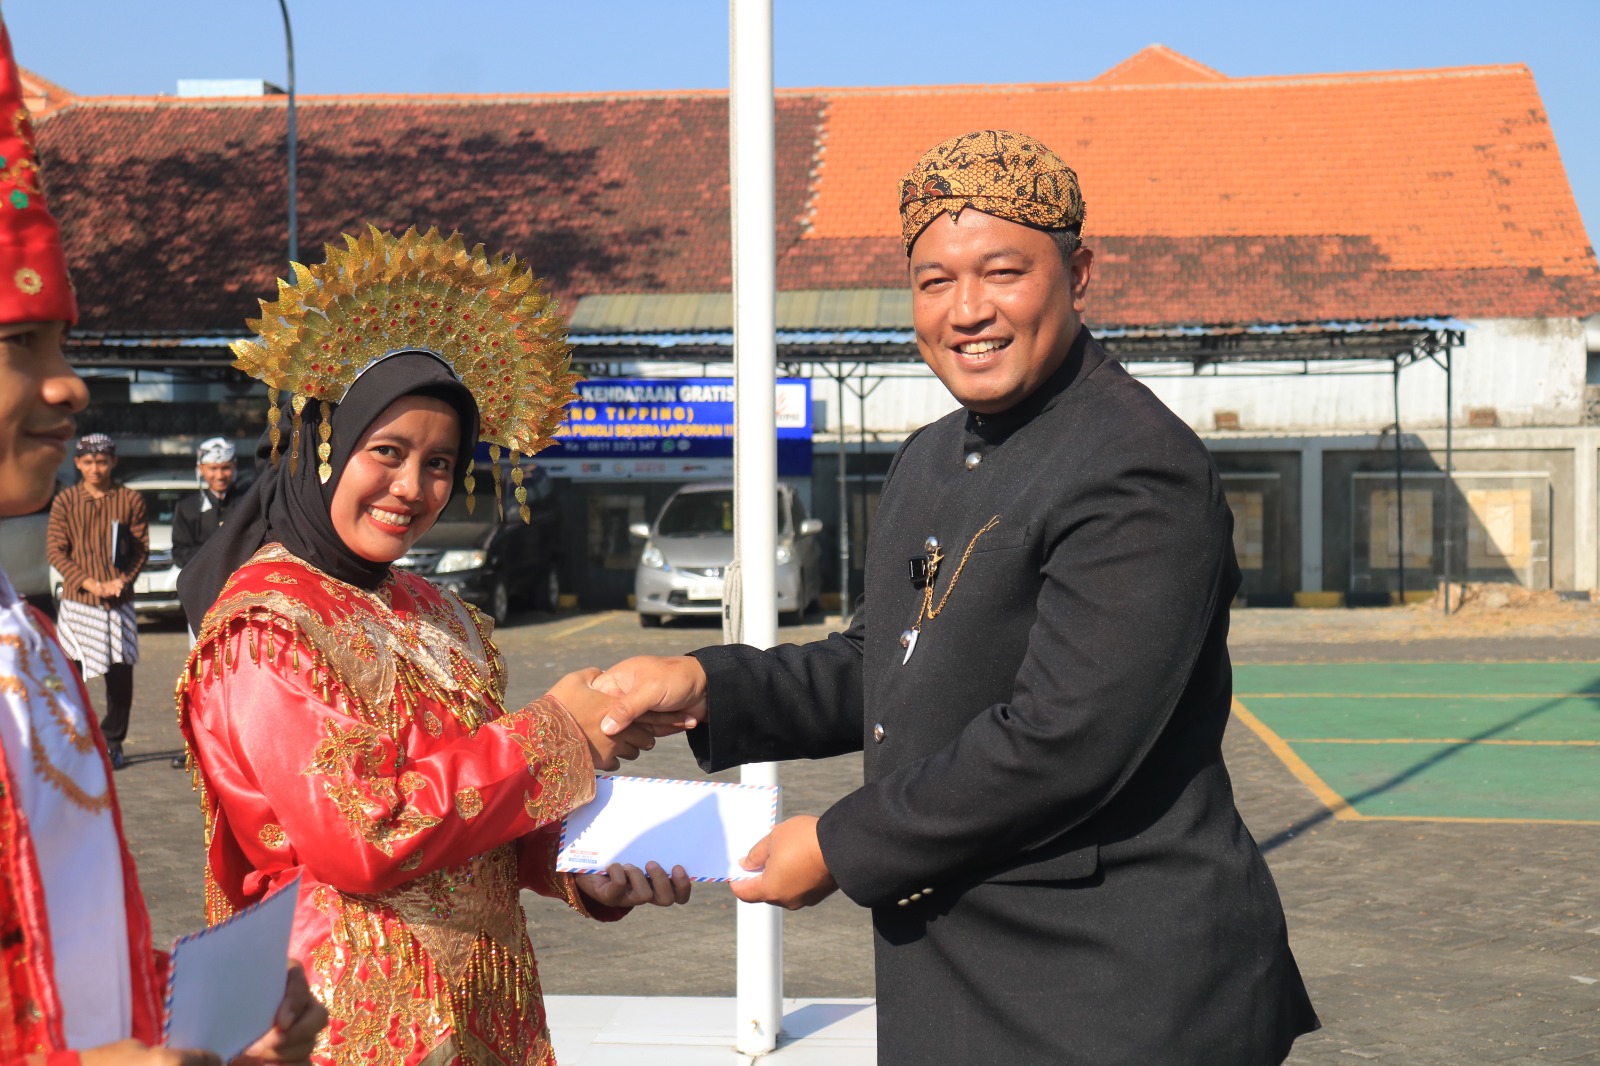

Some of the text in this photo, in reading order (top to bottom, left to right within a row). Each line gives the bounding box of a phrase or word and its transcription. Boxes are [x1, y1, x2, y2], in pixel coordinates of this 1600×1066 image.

[582, 386, 677, 403] KENDARAAN
[679, 385, 734, 403] GRATIS
[605, 406, 694, 423] TIPPING)
[571, 424, 614, 437] PUNGLI
[661, 424, 723, 437] LAPORKAN
